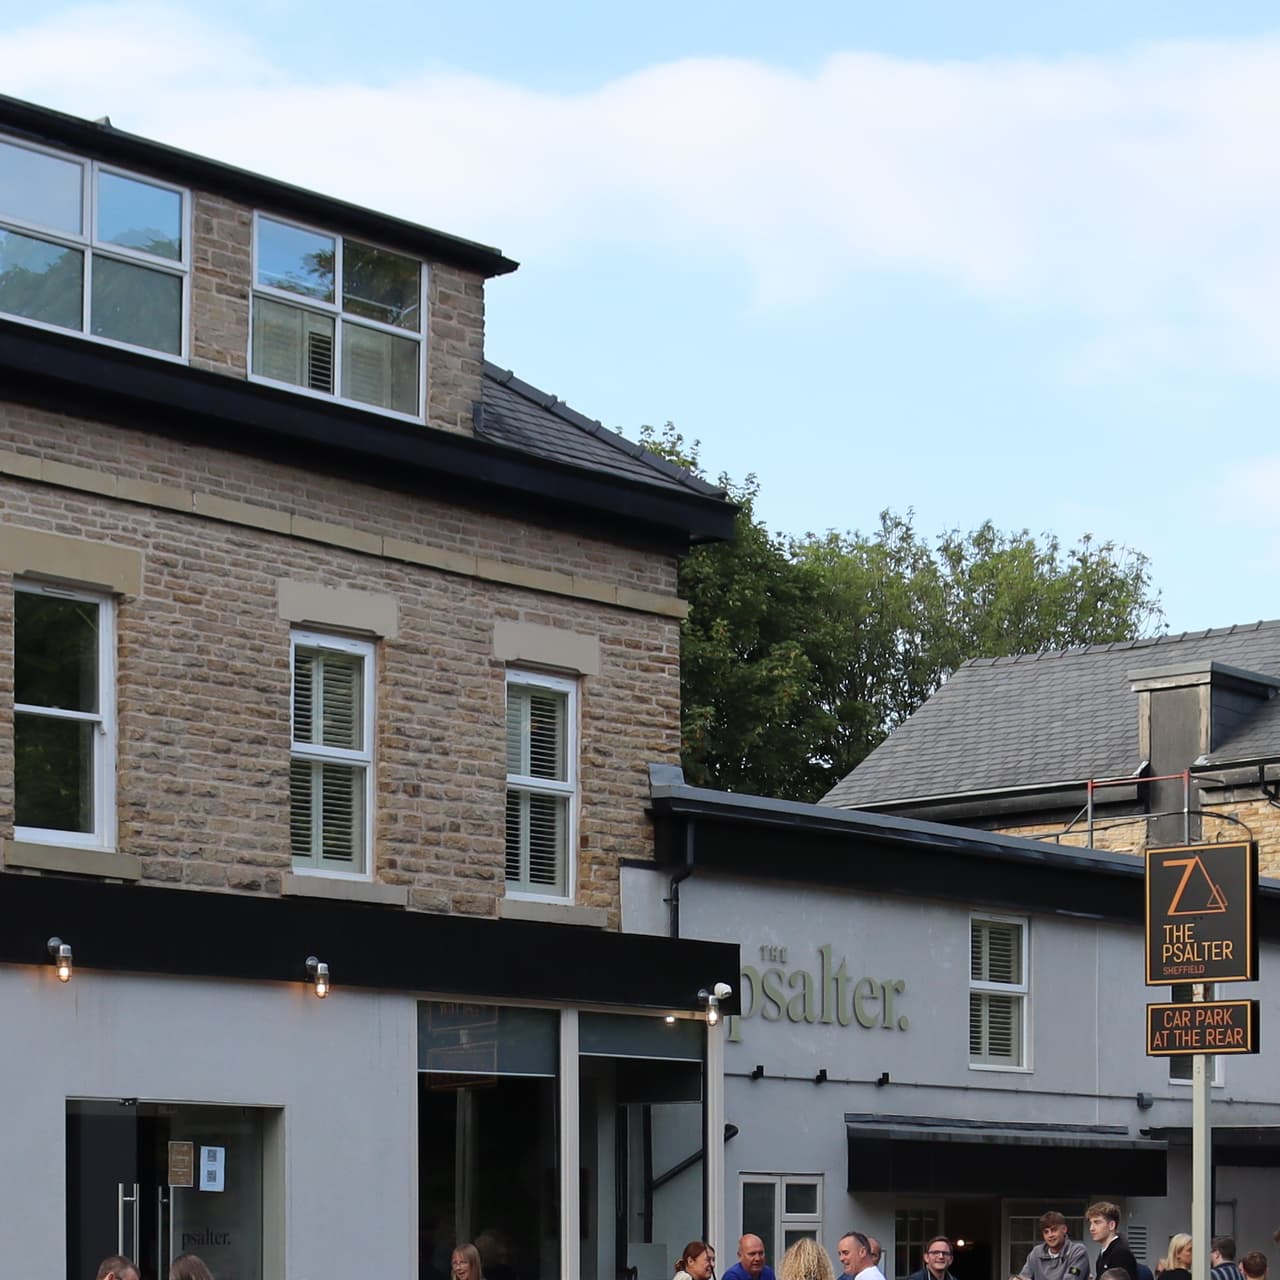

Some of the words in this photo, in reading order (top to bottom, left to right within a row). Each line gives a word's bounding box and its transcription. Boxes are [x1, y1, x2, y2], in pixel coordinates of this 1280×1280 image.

[1162, 923, 1195, 944] THE
[1162, 940, 1234, 964] PSALTER
[1162, 964, 1206, 976] SHEFFIELD
[1163, 1010, 1191, 1028] CAR
[1195, 1007, 1233, 1026] PARK
[1153, 1031, 1172, 1048] AT
[1173, 1029, 1201, 1047] THE
[1205, 1027, 1244, 1046] REAR
